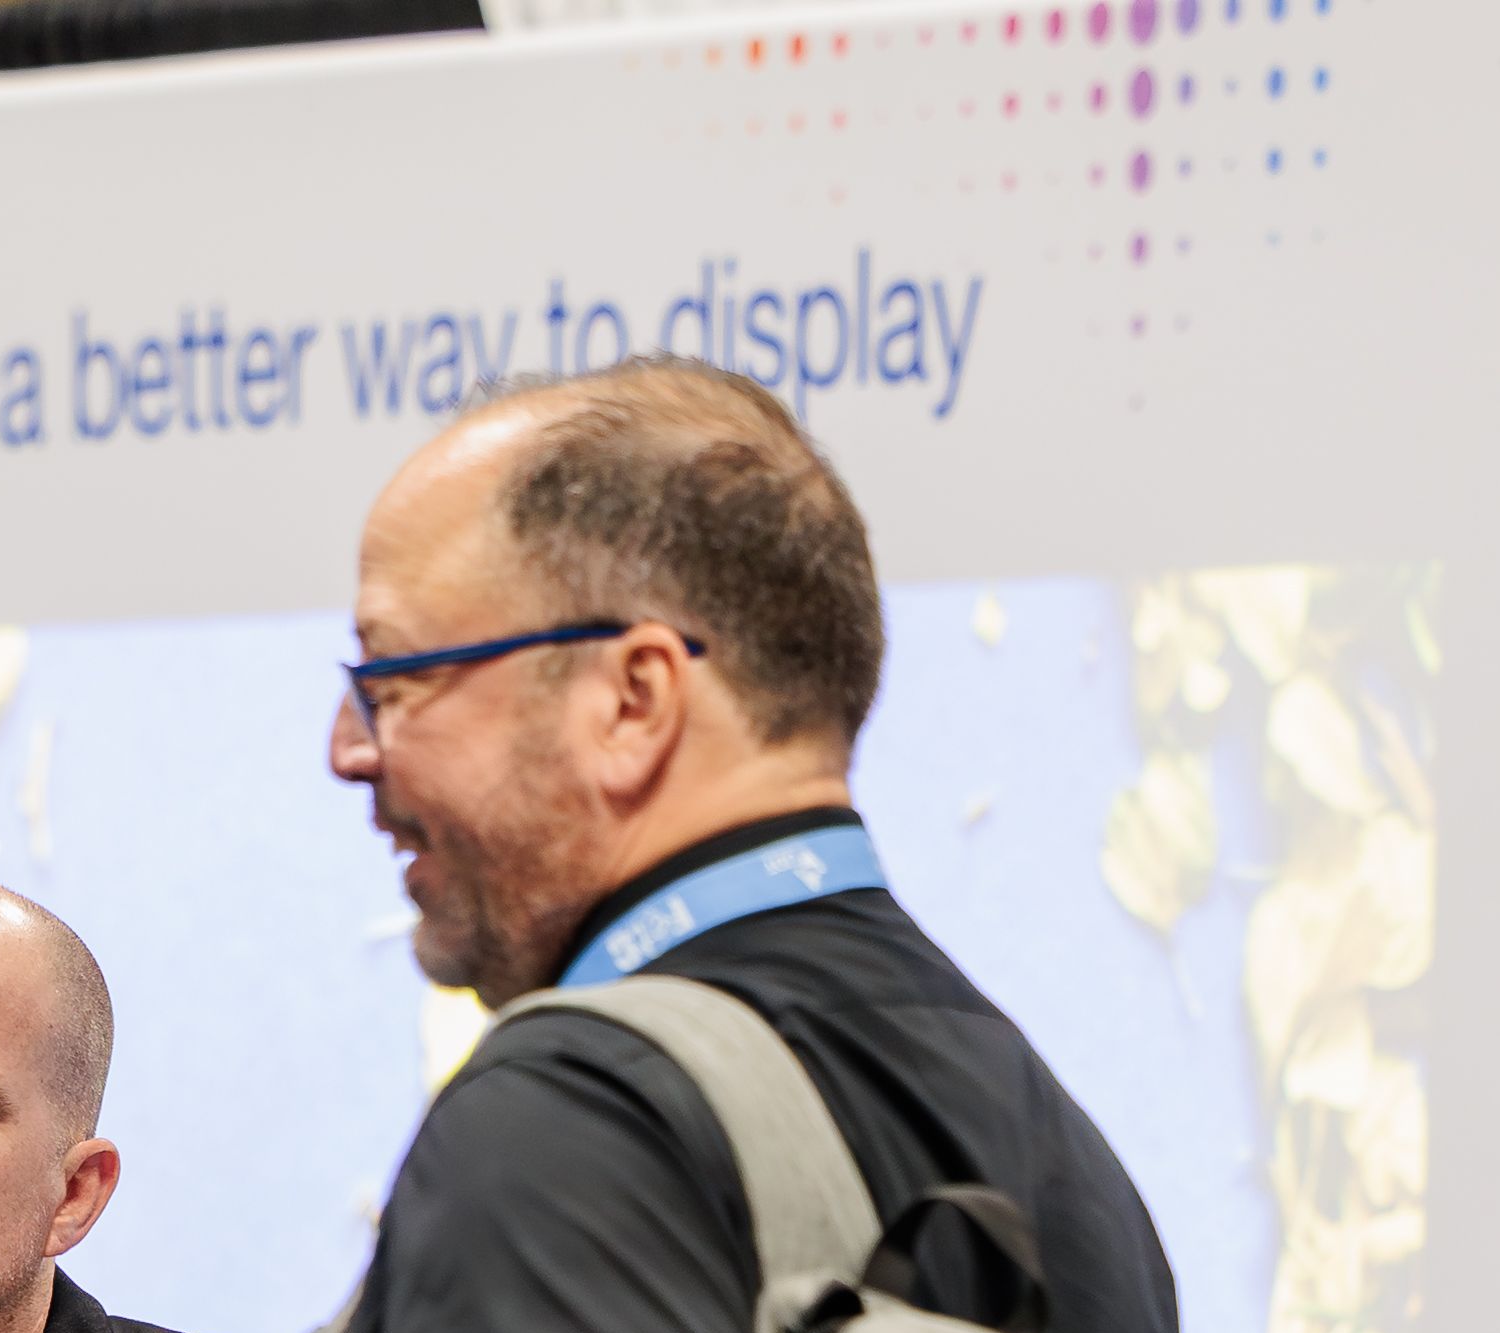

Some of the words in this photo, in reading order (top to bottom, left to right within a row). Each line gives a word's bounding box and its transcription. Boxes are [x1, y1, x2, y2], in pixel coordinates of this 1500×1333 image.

[0, 342, 45, 448] a
[73, 308, 315, 440] better
[340, 308, 518, 416] way
